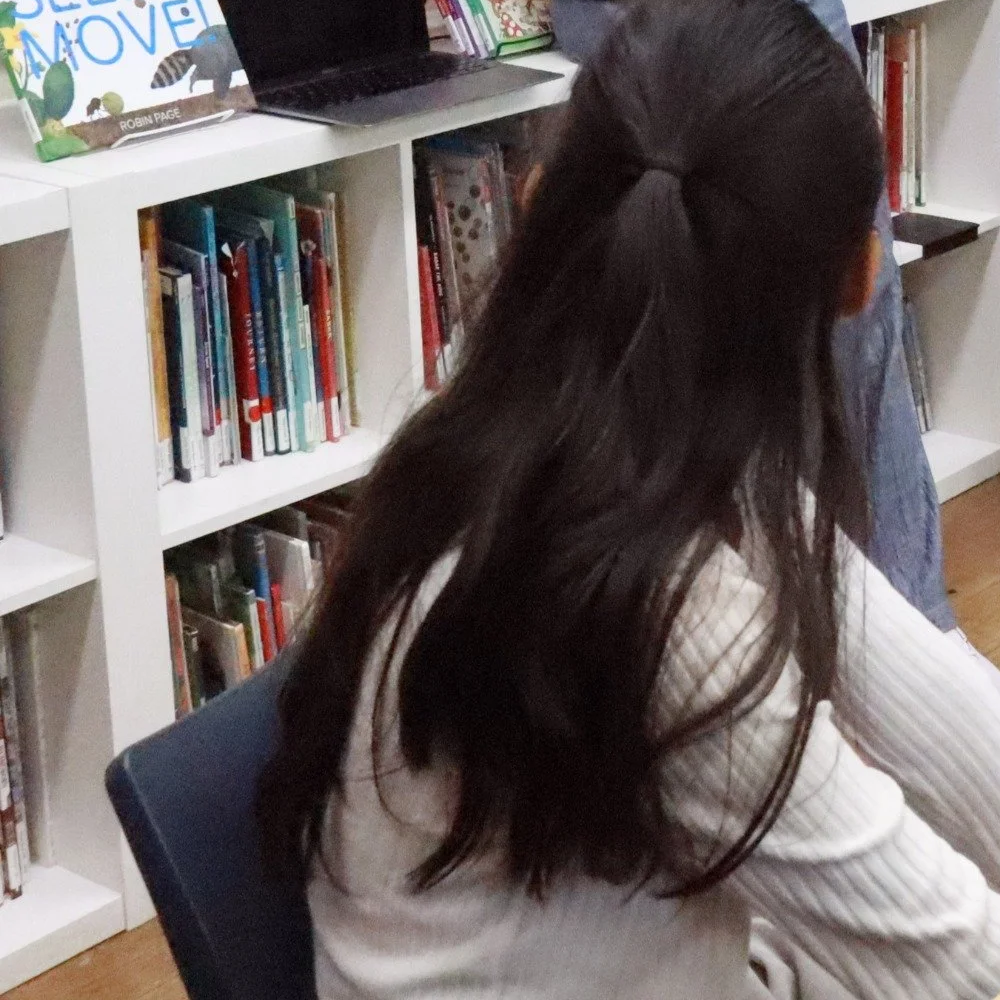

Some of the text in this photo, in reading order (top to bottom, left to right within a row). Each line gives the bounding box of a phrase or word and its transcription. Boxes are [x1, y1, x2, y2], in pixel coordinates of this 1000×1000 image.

[120, 108, 181, 131] ROBIN PAGE
[246, 312, 256, 371] JOURNEY
